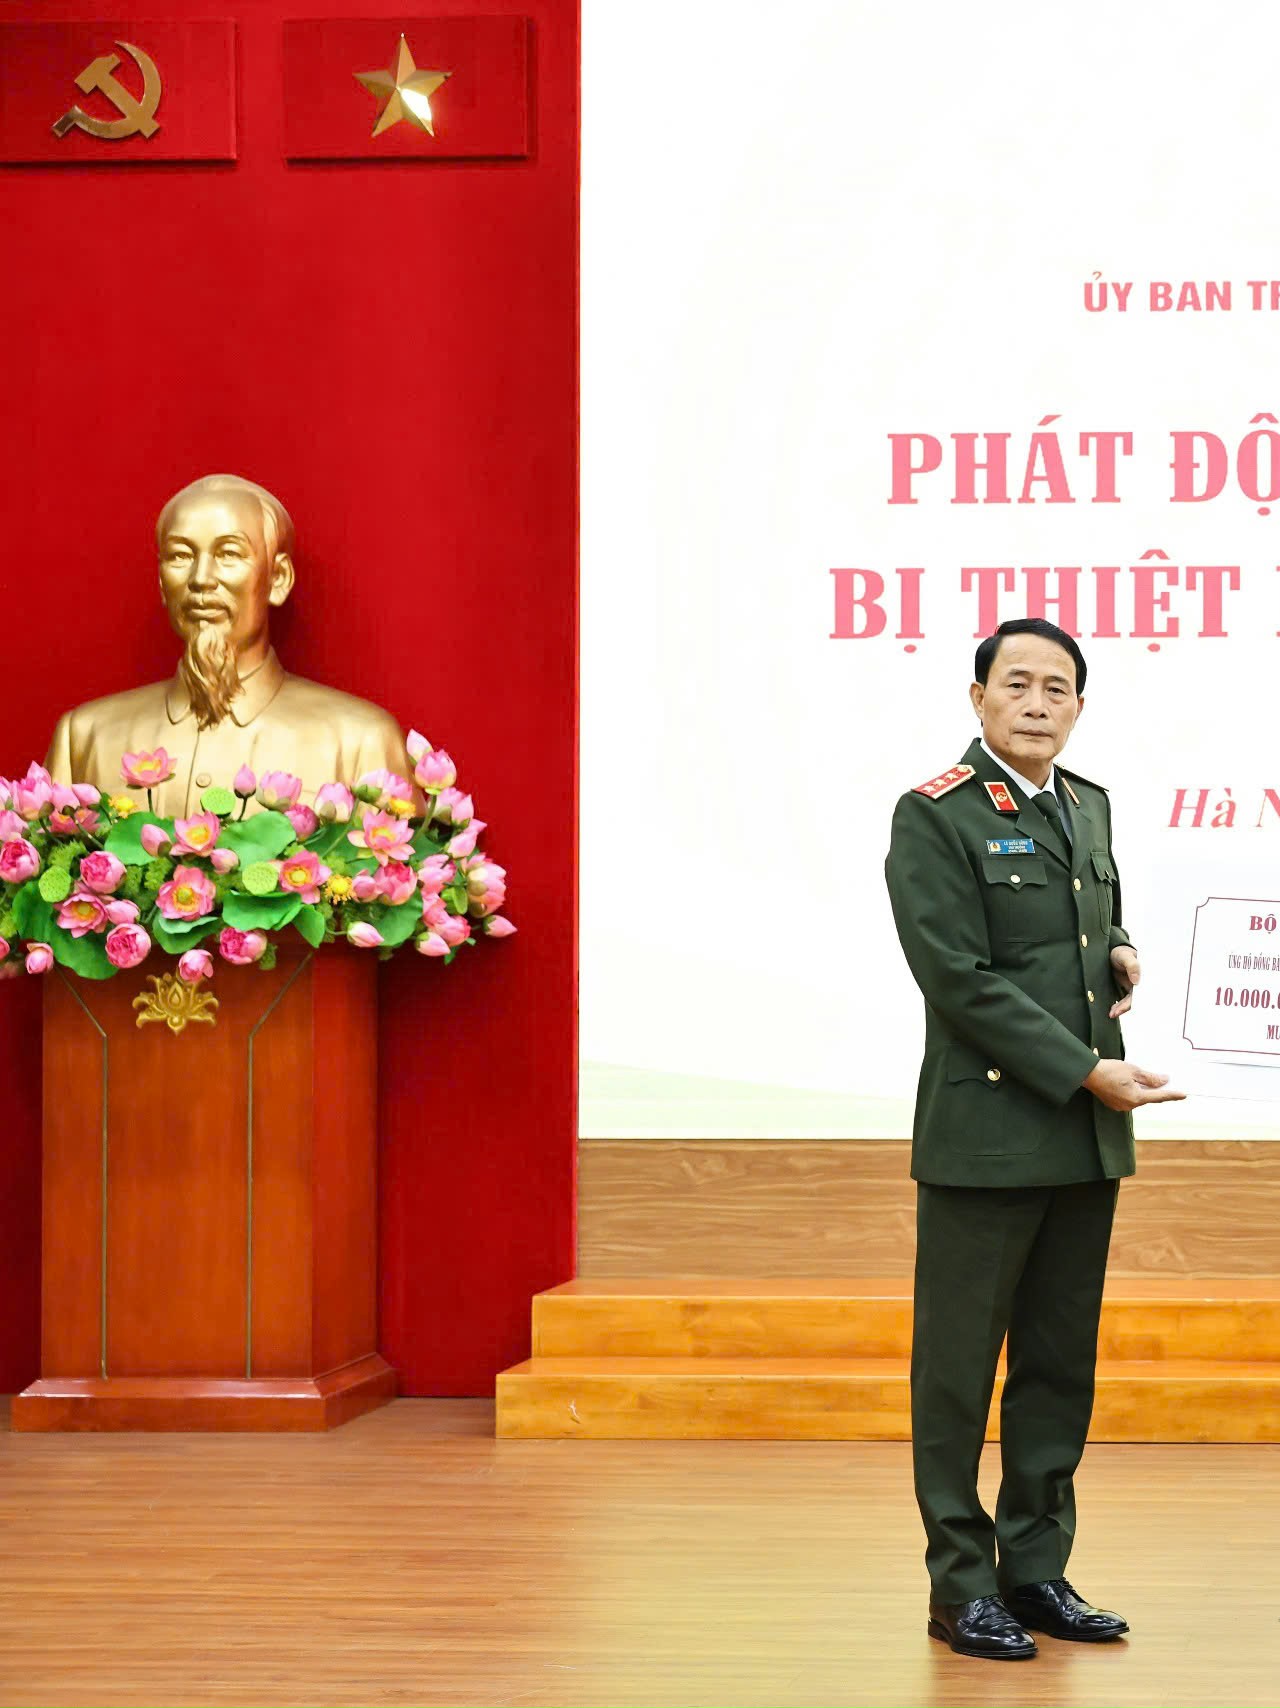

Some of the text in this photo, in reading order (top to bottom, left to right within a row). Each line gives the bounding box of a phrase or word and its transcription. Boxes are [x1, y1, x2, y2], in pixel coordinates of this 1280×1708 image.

[1083, 271, 1133, 313] ỦY
[1149, 281, 1232, 312] BAN
[887, 414, 1134, 505] PHÁT
[828, 567, 926, 654] BỊ
[960, 548, 1241, 653] THIỆT
[1167, 786, 1237, 829] Hà
[1249, 913, 1278, 935] BỘ
